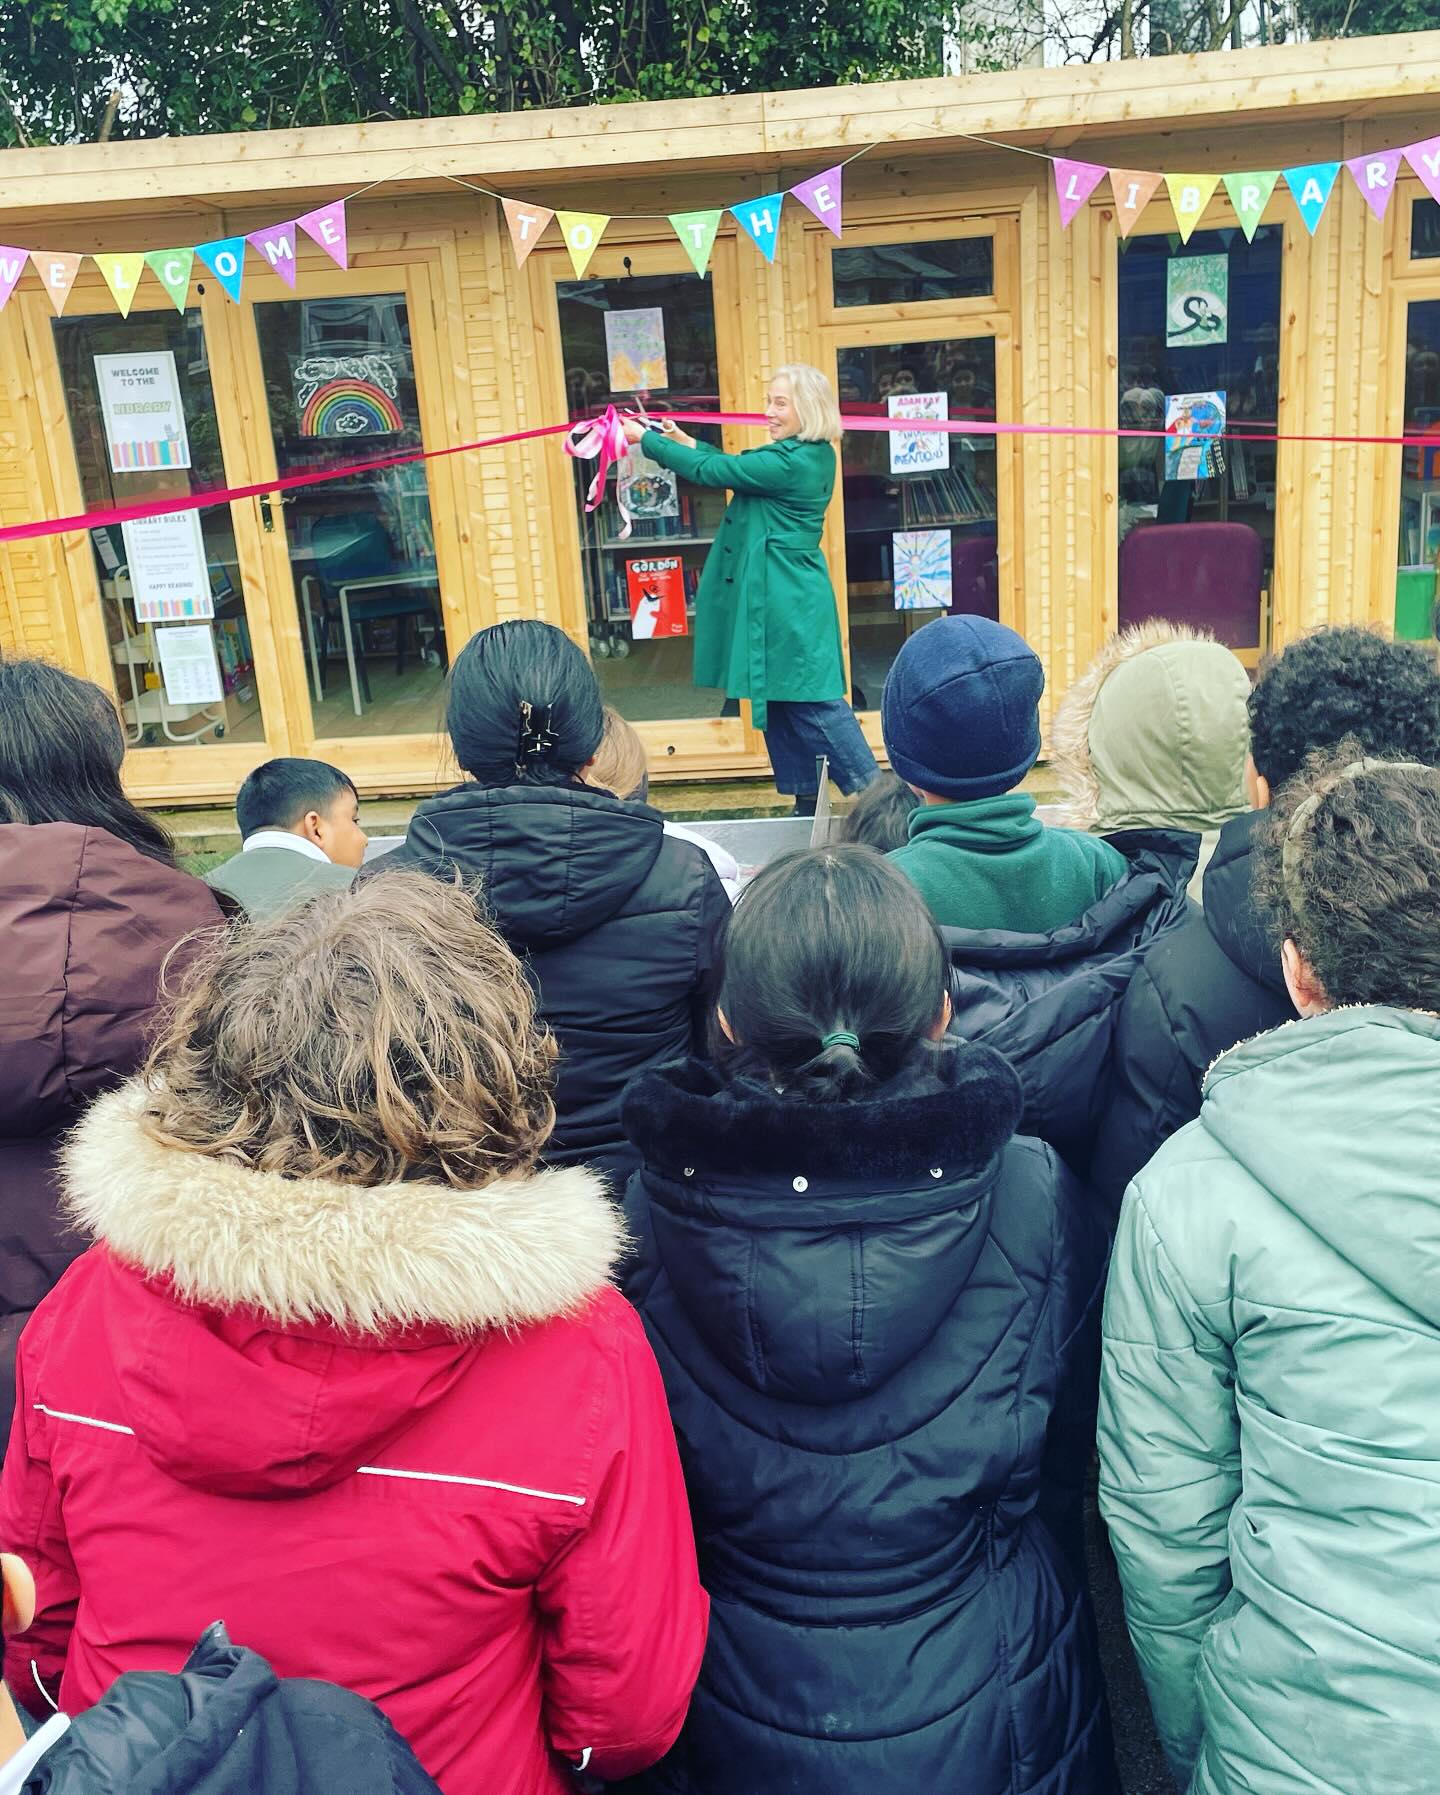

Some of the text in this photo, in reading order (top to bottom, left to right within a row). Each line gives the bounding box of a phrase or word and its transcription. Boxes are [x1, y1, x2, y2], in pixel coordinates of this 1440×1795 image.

[517, 214, 592, 250] TO
[688, 184, 837, 249] THE
[1065, 149, 1440, 213] LIBRARY
[111, 367, 160, 377] WELCOME
[121, 377, 155, 386] TO THE
[112, 400, 172, 415] LIBRARY
[632, 559, 679, 573] GORDON
